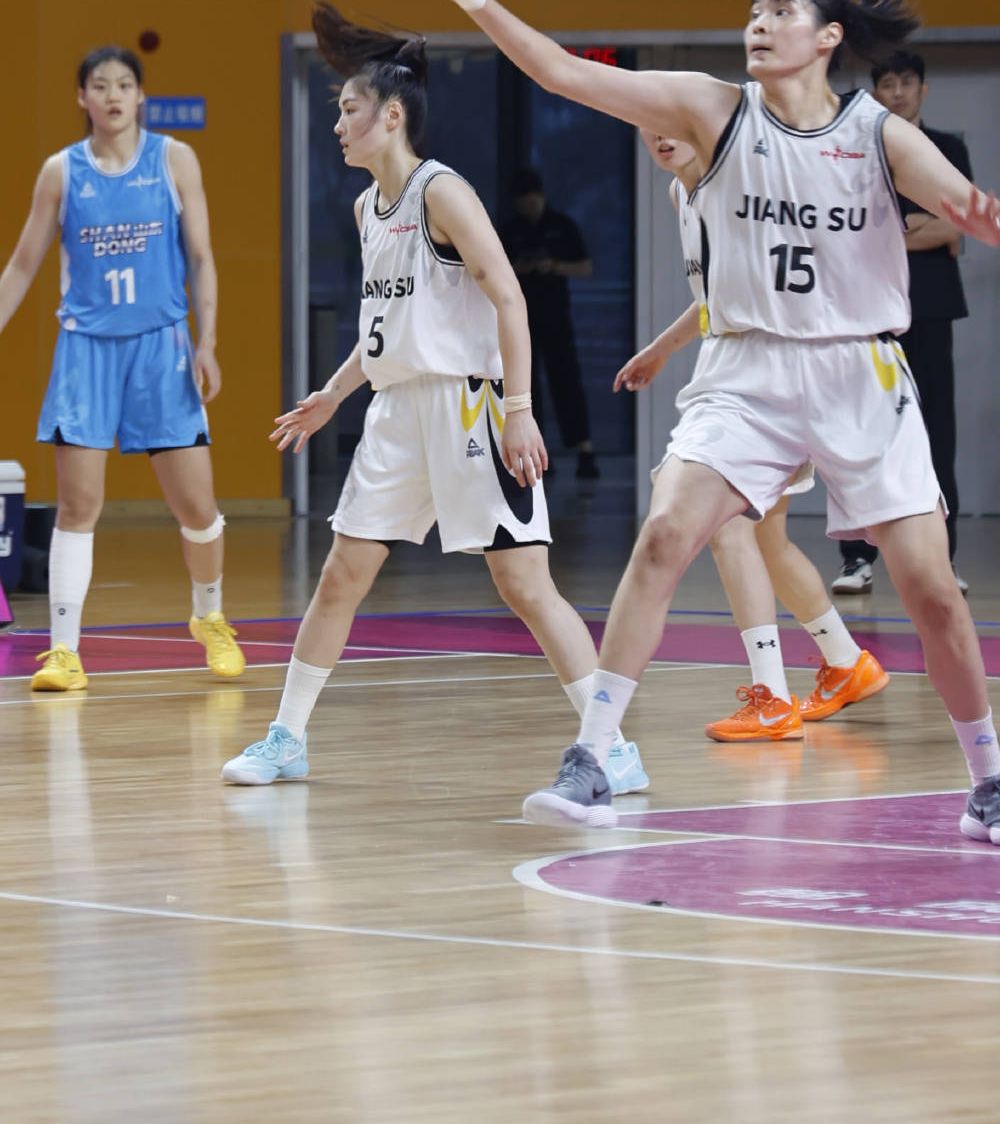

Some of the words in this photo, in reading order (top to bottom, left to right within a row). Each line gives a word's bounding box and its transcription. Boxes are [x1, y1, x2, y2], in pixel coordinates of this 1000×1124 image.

[735, 194, 818, 230] JIANG
[827, 206, 867, 232] SU
[79, 223, 132, 244] SHAN
[93, 237, 147, 257] DONG
[104, 267, 136, 305] 11
[394, 276, 415, 298] SU
[769, 243, 816, 294] 15
[367, 316, 385, 358] 5
